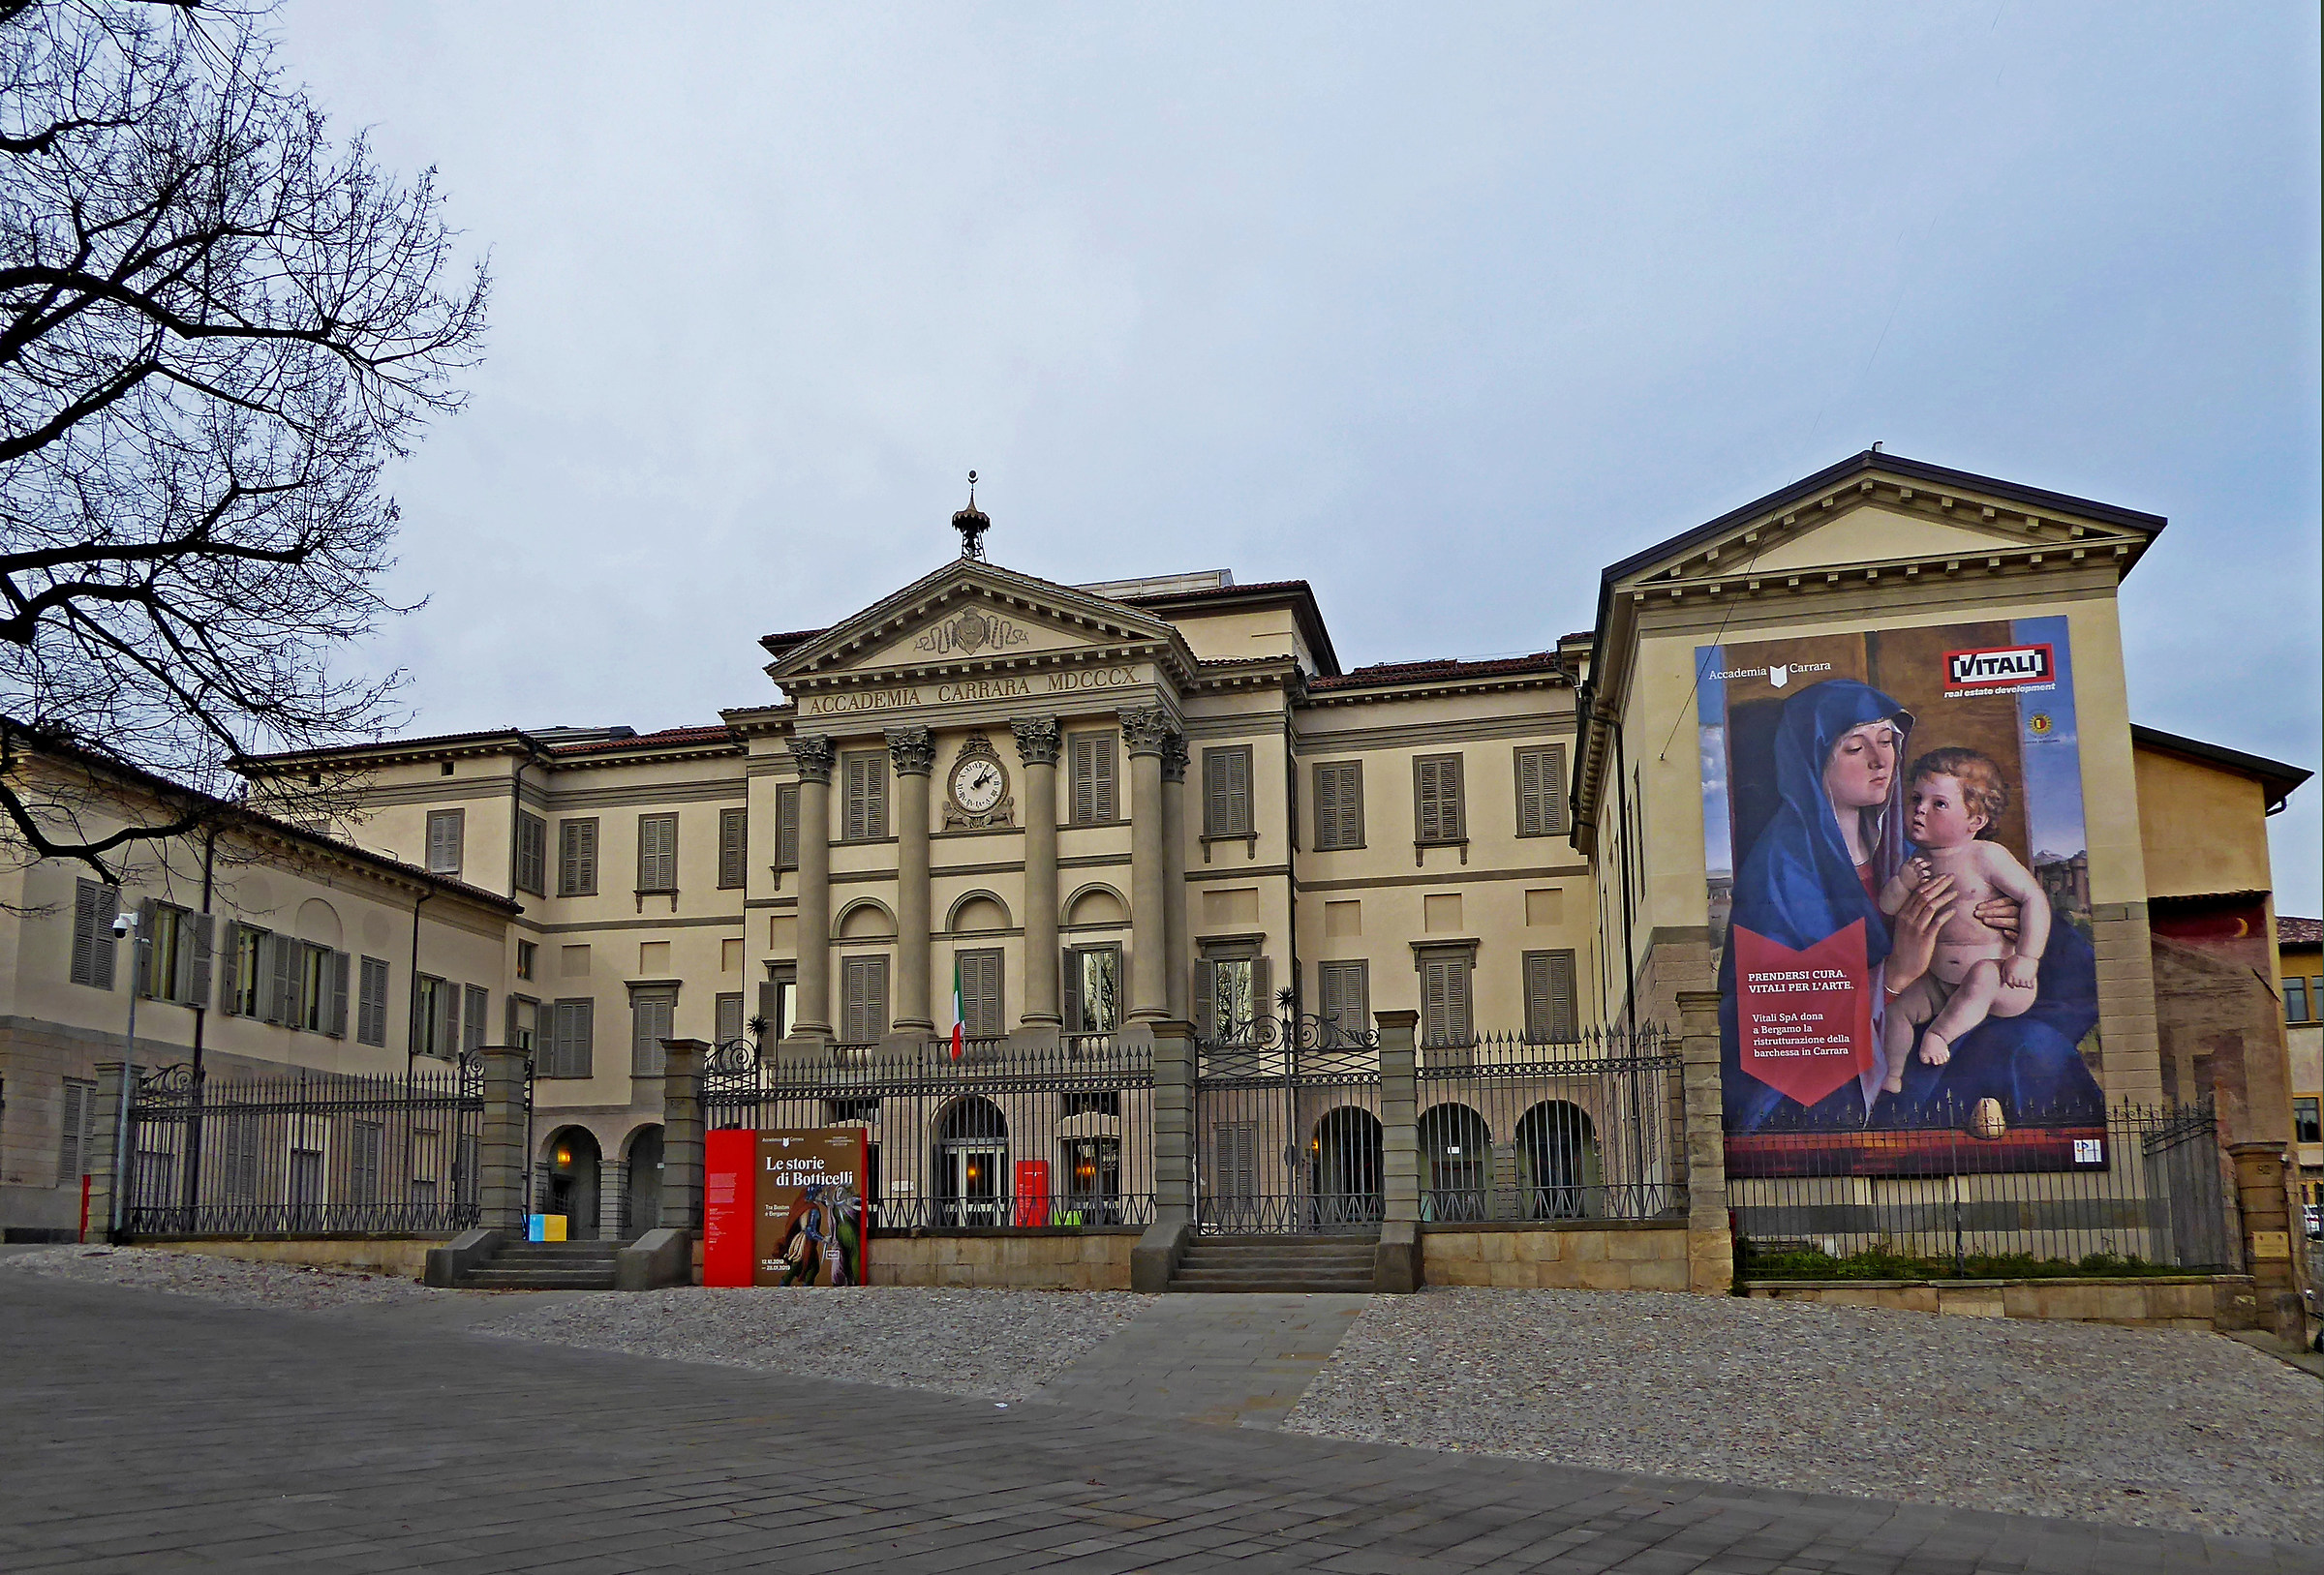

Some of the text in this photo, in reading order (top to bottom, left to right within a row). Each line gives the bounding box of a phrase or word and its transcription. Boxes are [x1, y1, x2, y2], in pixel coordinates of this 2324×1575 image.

[1708, 662, 1831, 680] Accademia Carrara
[1960, 654, 2036, 677] VITALI
[810, 688, 921, 714] ACCADEMIA
[937, 678, 1030, 702] CARRARA
[1944, 682, 2056, 698] real estate development
[1748, 969, 1847, 982] PRENDERSI CURA.
[1748, 984, 1786, 993] VITALI
[1789, 983, 1810, 991] PER
[1752, 1012, 1823, 1023] Vitali SpA dona
[1761, 1025, 1801, 1035] Bergamo
[1753, 1034, 1850, 1045] ristrutturazione della
[1754, 1046, 1849, 1058] barchessa in Carrara
[766, 1155, 825, 1170] Le storie
[776, 1170, 853, 1186] di Botticelli
